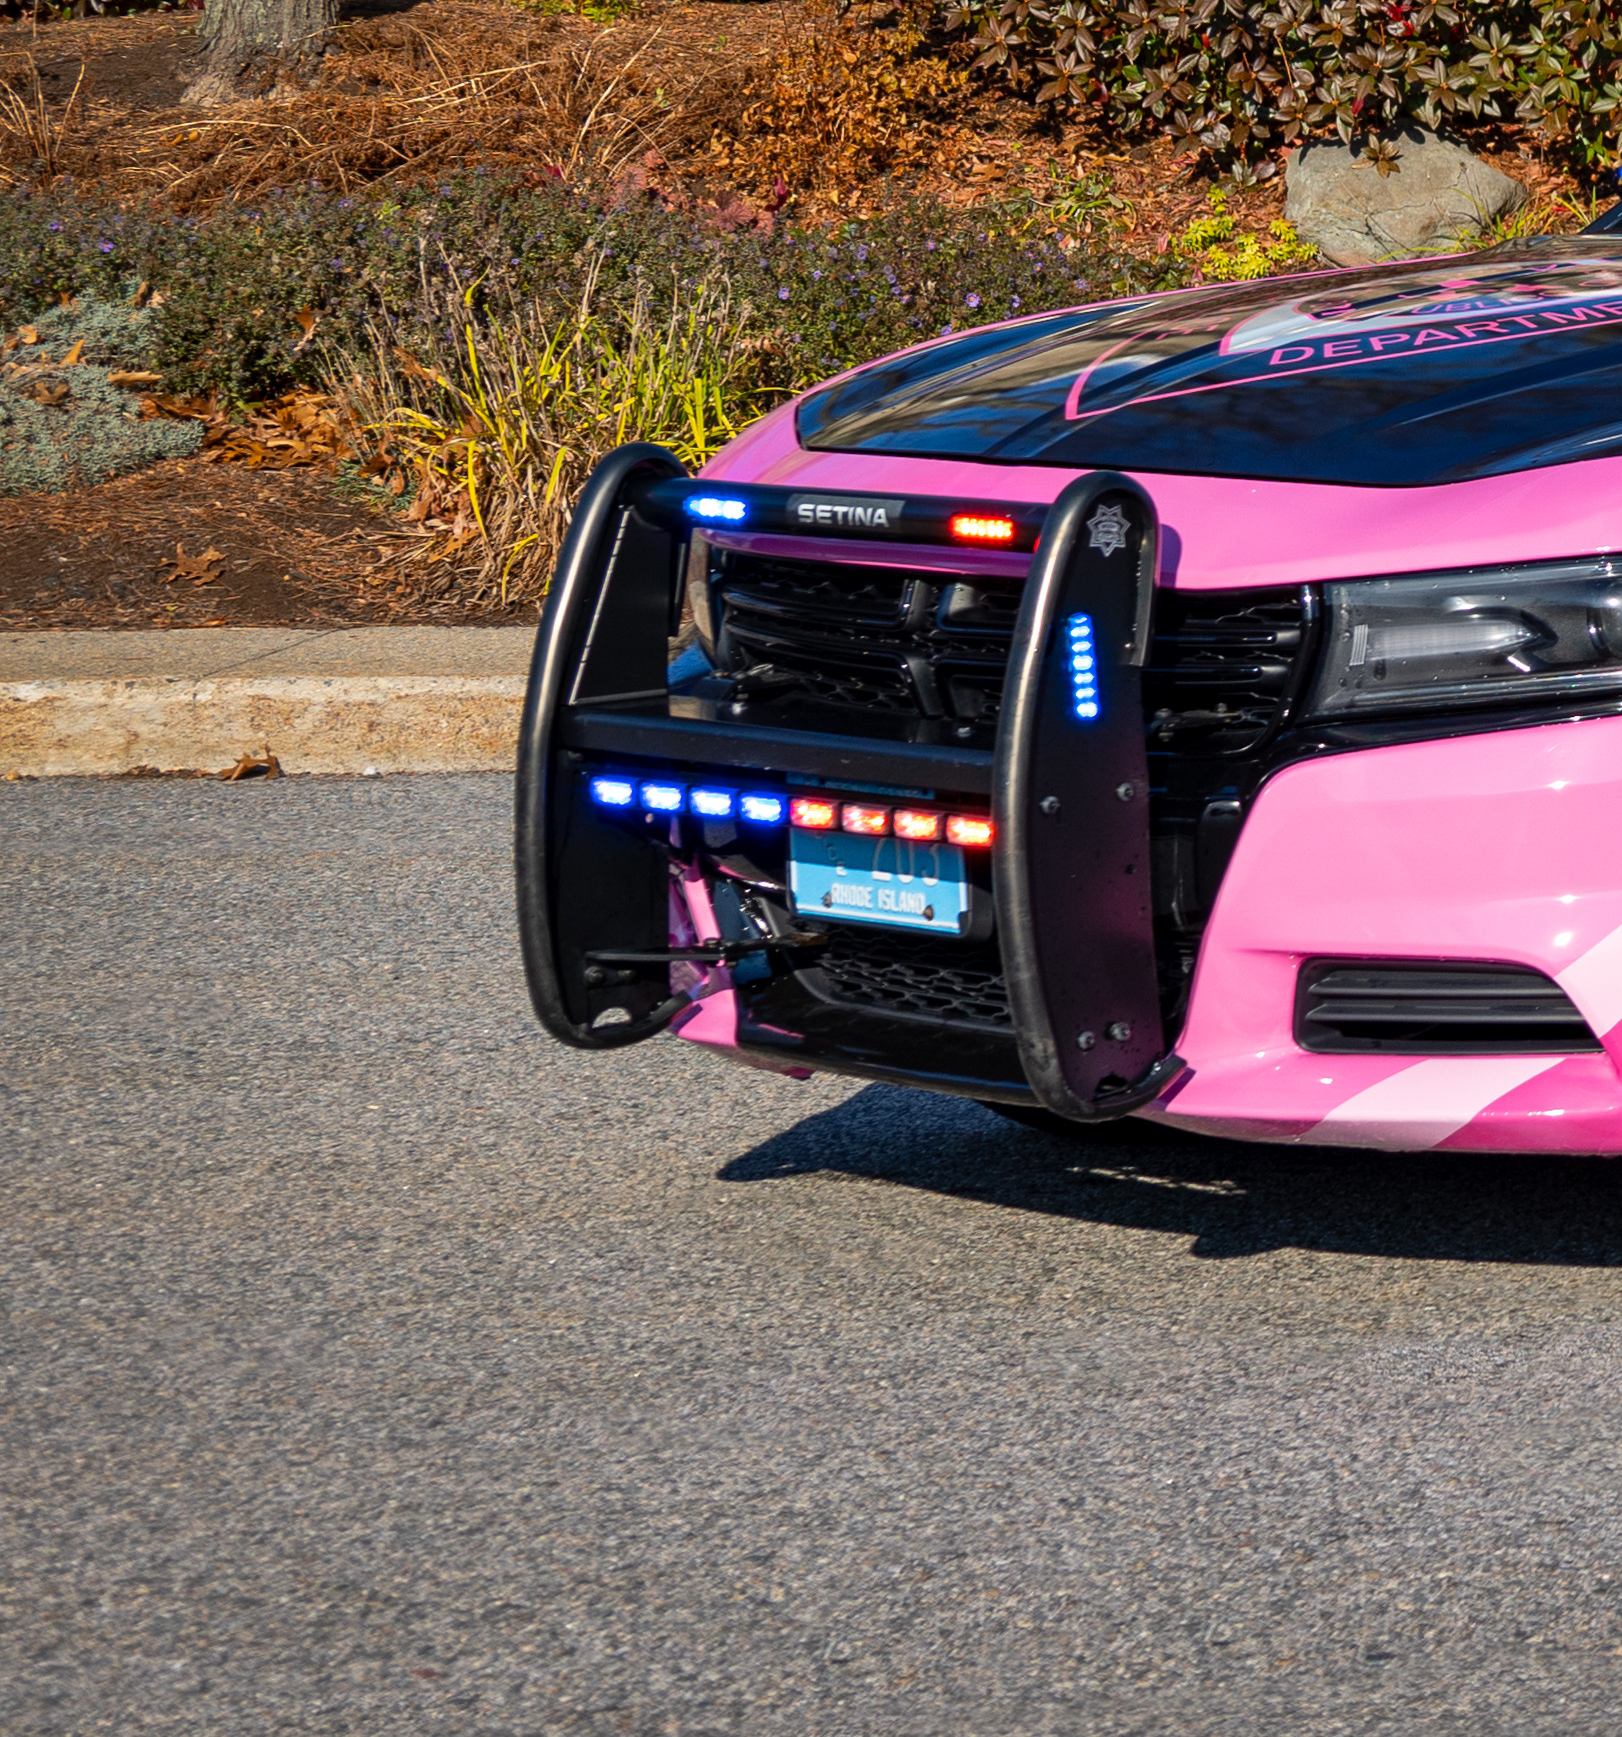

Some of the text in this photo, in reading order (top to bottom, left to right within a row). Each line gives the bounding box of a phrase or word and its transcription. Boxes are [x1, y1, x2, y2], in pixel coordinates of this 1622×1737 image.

[798, 503, 890, 528] SETINA
[831, 882, 927, 914] RHODE ISLAND
